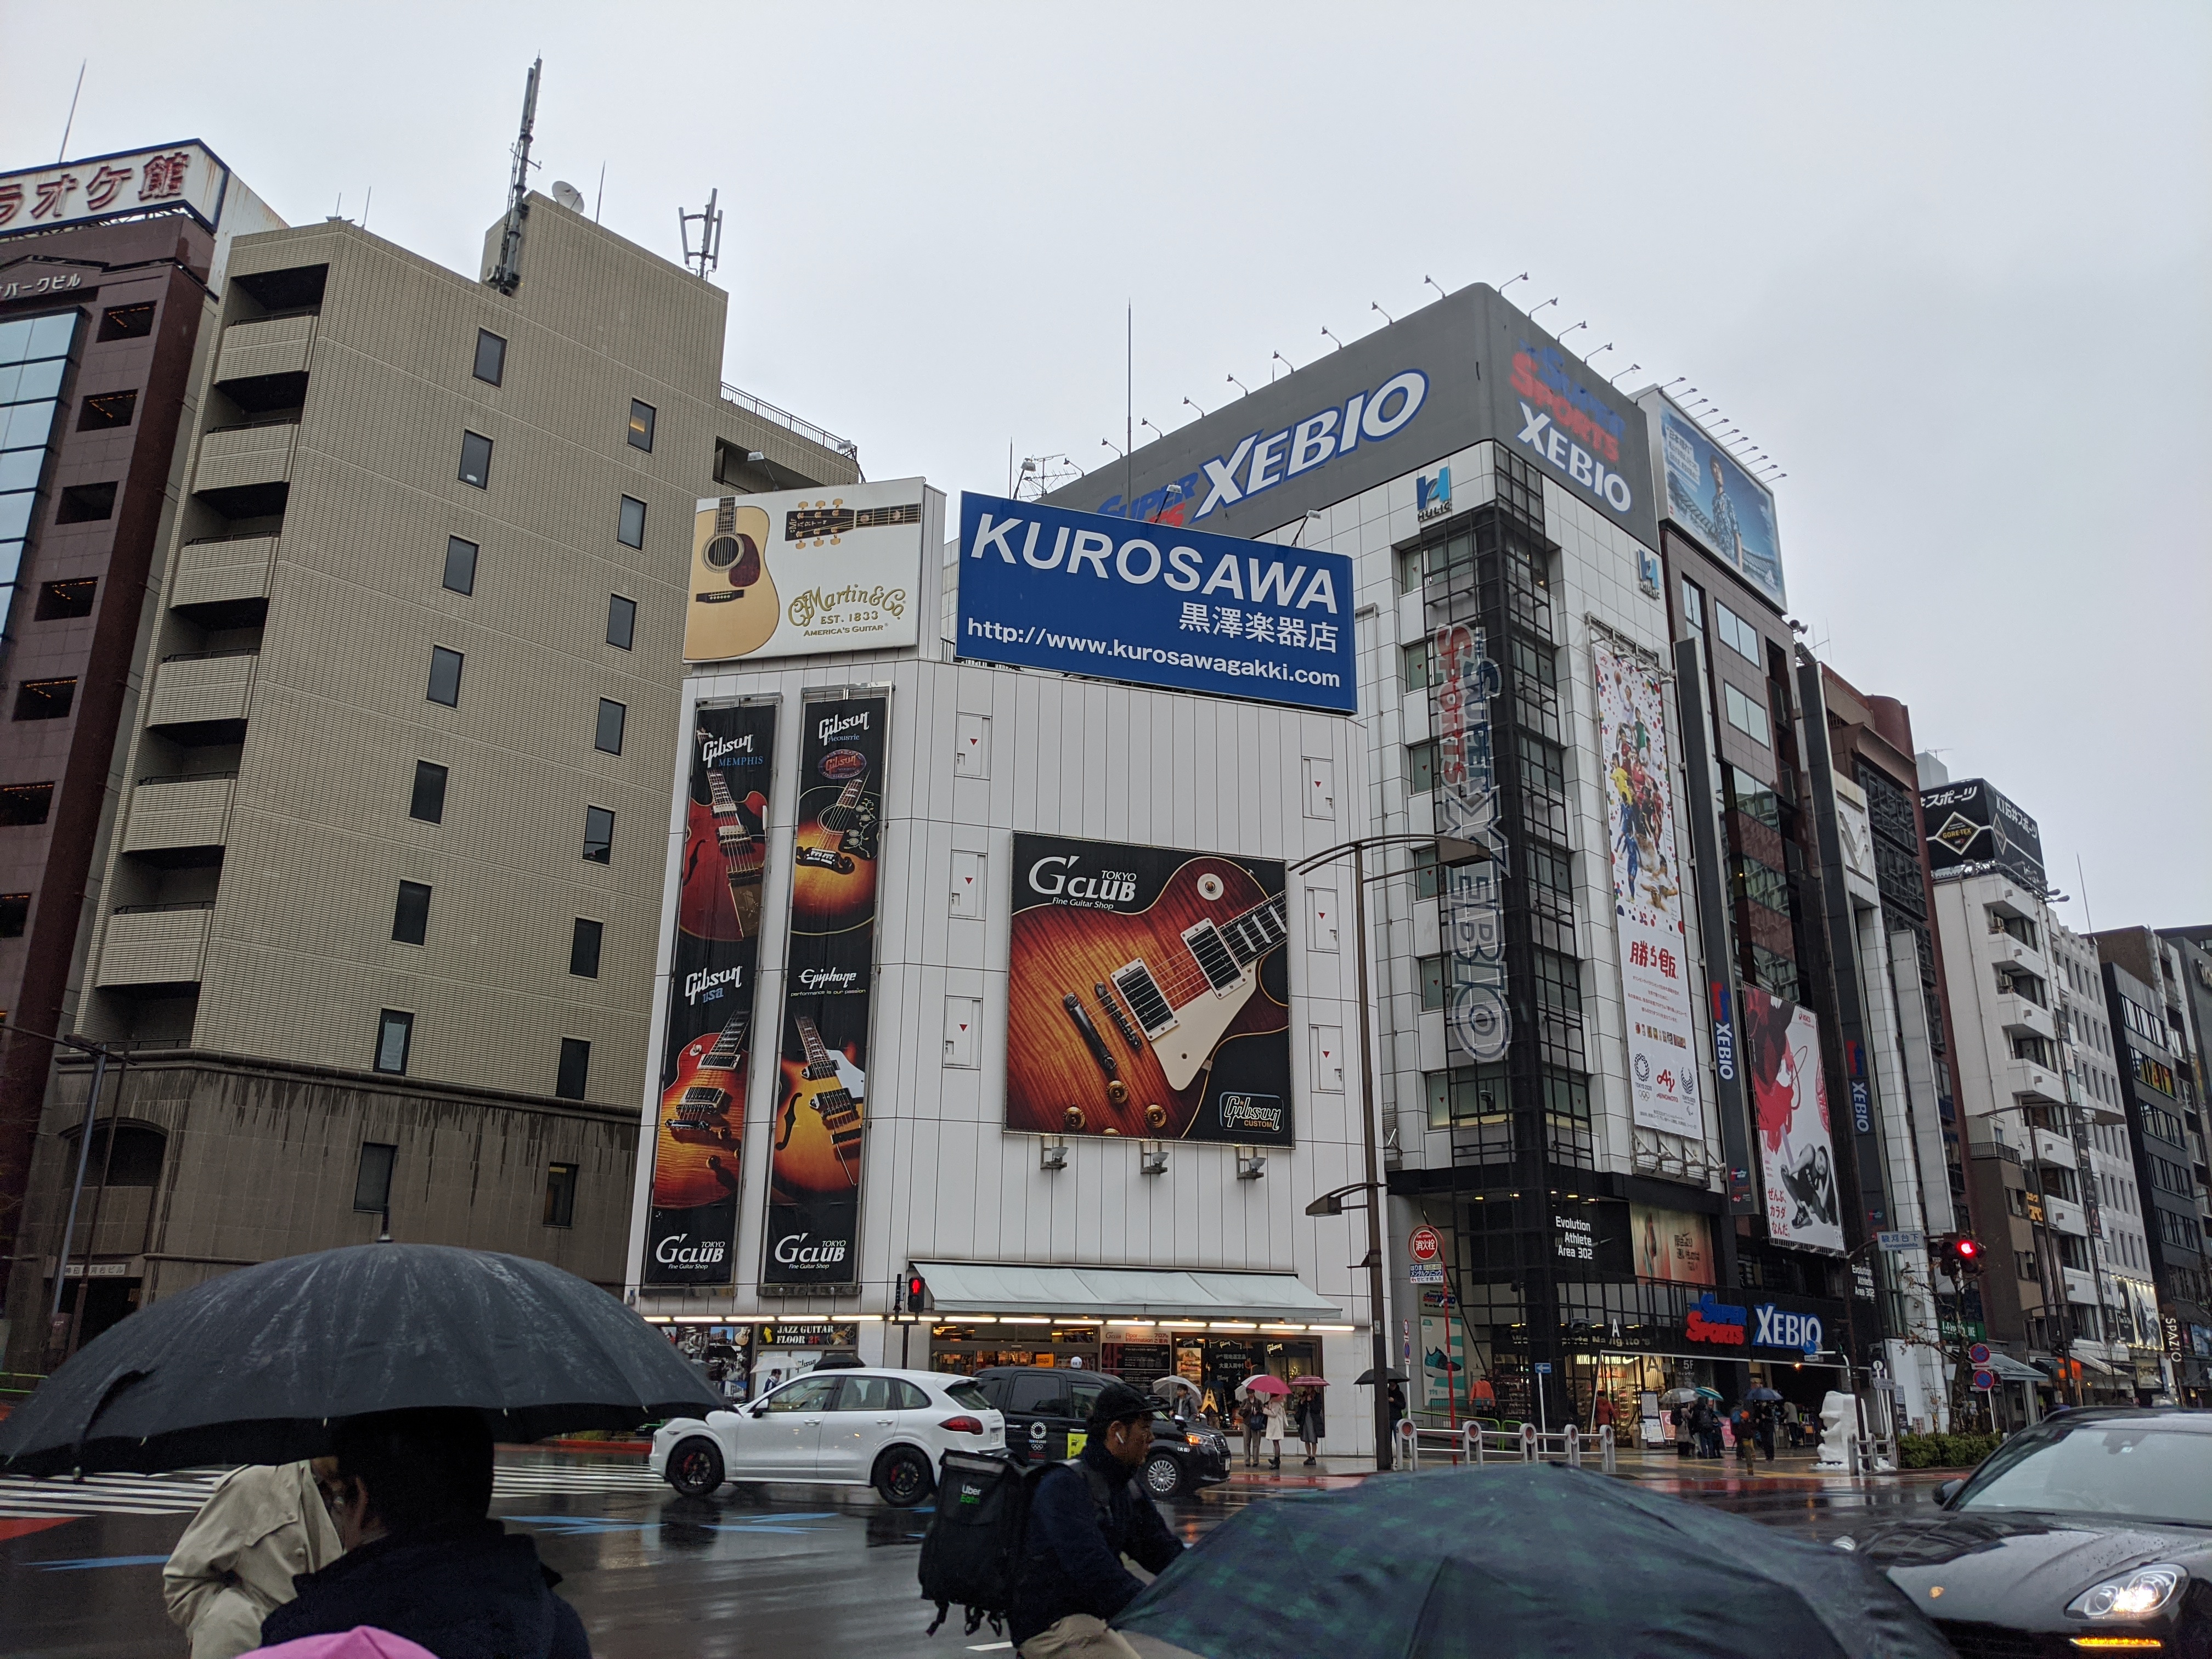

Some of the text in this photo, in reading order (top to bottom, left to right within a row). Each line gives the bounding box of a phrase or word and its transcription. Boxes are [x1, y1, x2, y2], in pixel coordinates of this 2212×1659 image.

[1510, 351, 1619, 462] SPORTS
[1192, 370, 1427, 522] XEBIO
[1517, 400, 1632, 512] XEBIO
[1418, 501, 1451, 522] HULIC
[970, 513, 1338, 614] KUROSAWA
[821, 610, 878, 625] EST. 1833
[803, 624, 884, 637] AMERICA'S GUITAR
[1179, 601, 1339, 653] 黒澤楽器店
[967, 617, 1341, 688] http://www.kurosawagakki.com
[819, 712, 869, 746] Gibson
[703, 734, 753, 768] Gibson
[719, 755, 764, 767] MEMPHIS
[826, 755, 856, 775] Gibson
[1942, 827, 1972, 839] GORE-TEX
[1101, 870, 1136, 881] TOKYO
[1052, 896, 1114, 911] Fine Guitar Shop
[685, 966, 743, 1006] Gibson
[798, 967, 857, 990] Epiphone
[702, 987, 724, 1004] usa
[1716, 1022, 1734, 1080] XEBIO
[1224, 1096, 1281, 1131] Gibson
[1851, 1081, 1870, 1132] XEBIO
[1244, 1120, 1272, 1128] CUSTOM
[1555, 1216, 1591, 1232] Evolution
[822, 1239, 847, 1248] TOKYO
[1415, 1239, 1436, 1251] 消火栓
[1564, 1232, 1592, 1246] Athlete
[1881, 1233, 1918, 1243] 駿河台下
[1558, 1244, 1593, 1260] Area 302
[1699, 1293, 1747, 1326] SUPER
[777, 1325, 834, 1334] JAZZ GUITAR
[1686, 1311, 1746, 1345] SPORTS
[1755, 1304, 1822, 1347] XEBIO
[776, 1335, 805, 1344] FLOOR
[2165, 1317, 2182, 1363] SPAZIO
[1267, 1343, 1283, 1355] Gibson
[1683, 1359, 1694, 1370] 5F
[962, 1484, 981, 1496] Uber
